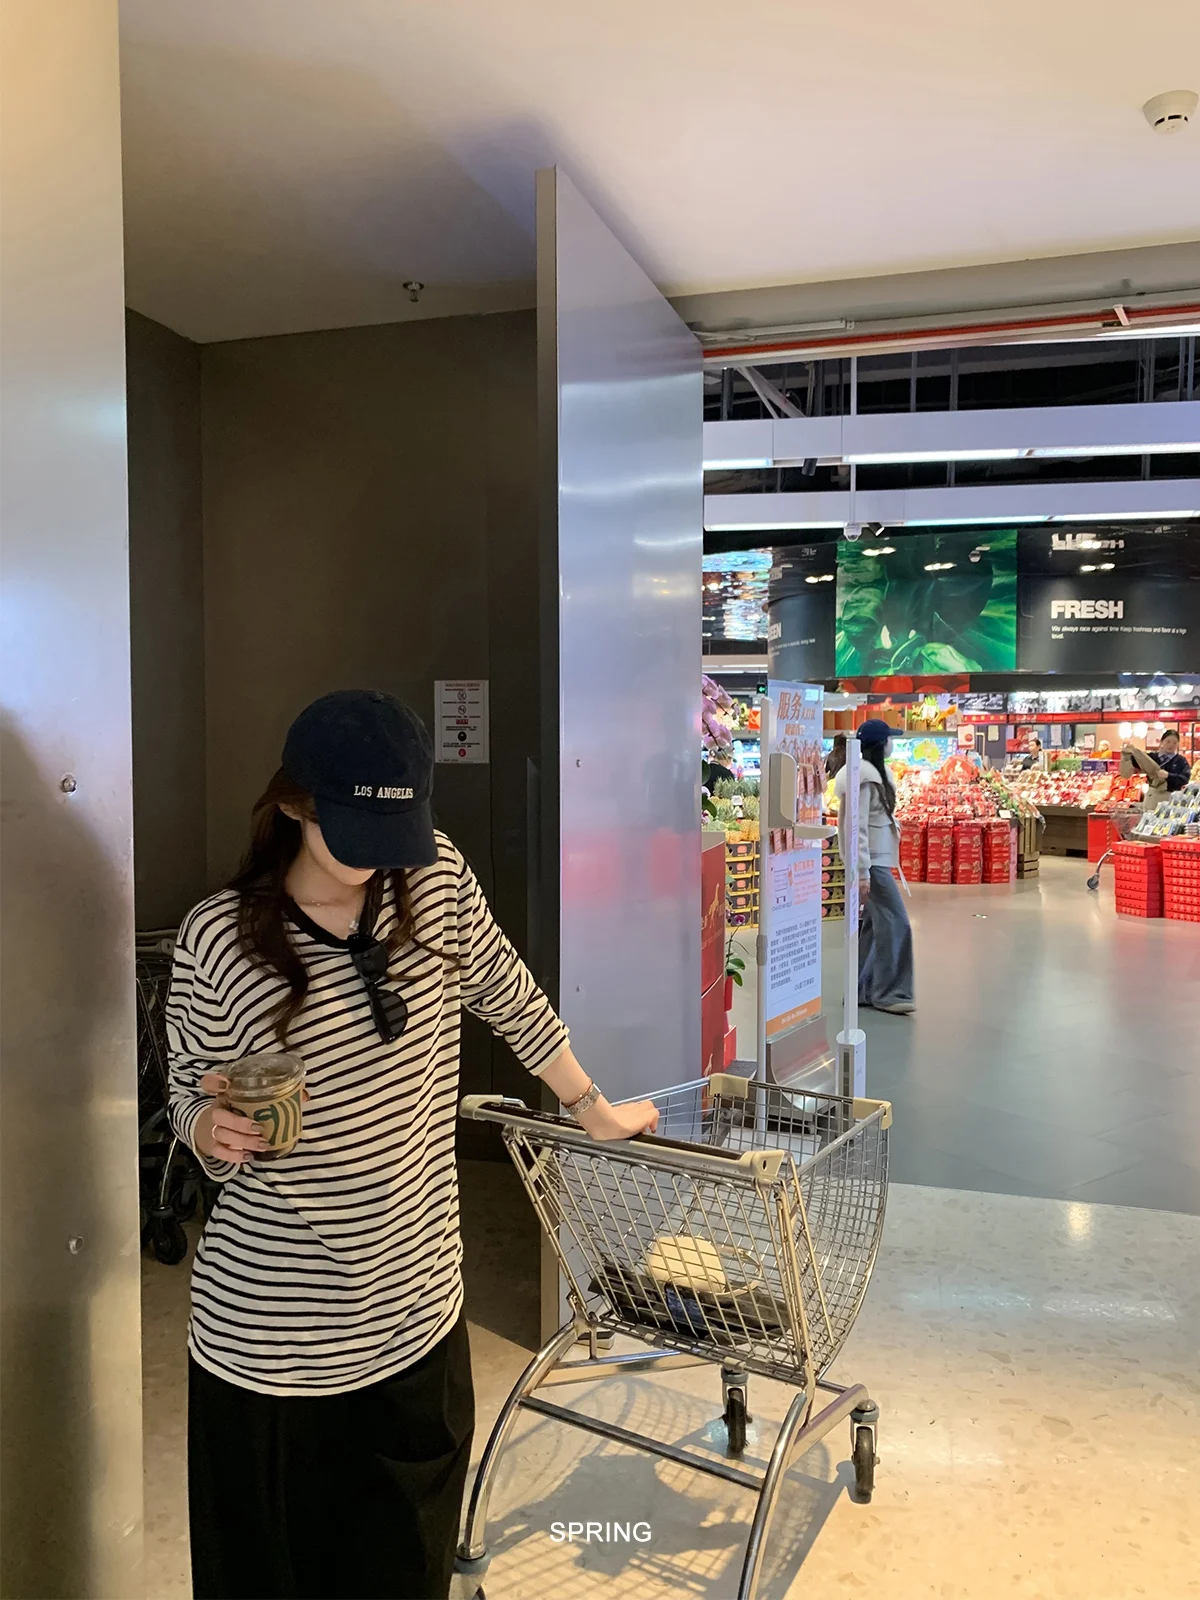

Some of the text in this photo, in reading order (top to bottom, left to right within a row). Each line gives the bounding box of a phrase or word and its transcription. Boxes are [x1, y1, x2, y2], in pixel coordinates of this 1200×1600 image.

[1051, 600, 1124, 619] FRESH
[1062, 625, 1078, 633] always
[1091, 625, 1109, 634] against
[777, 691, 802, 721] 服务
[353, 785, 373, 797] LOS
